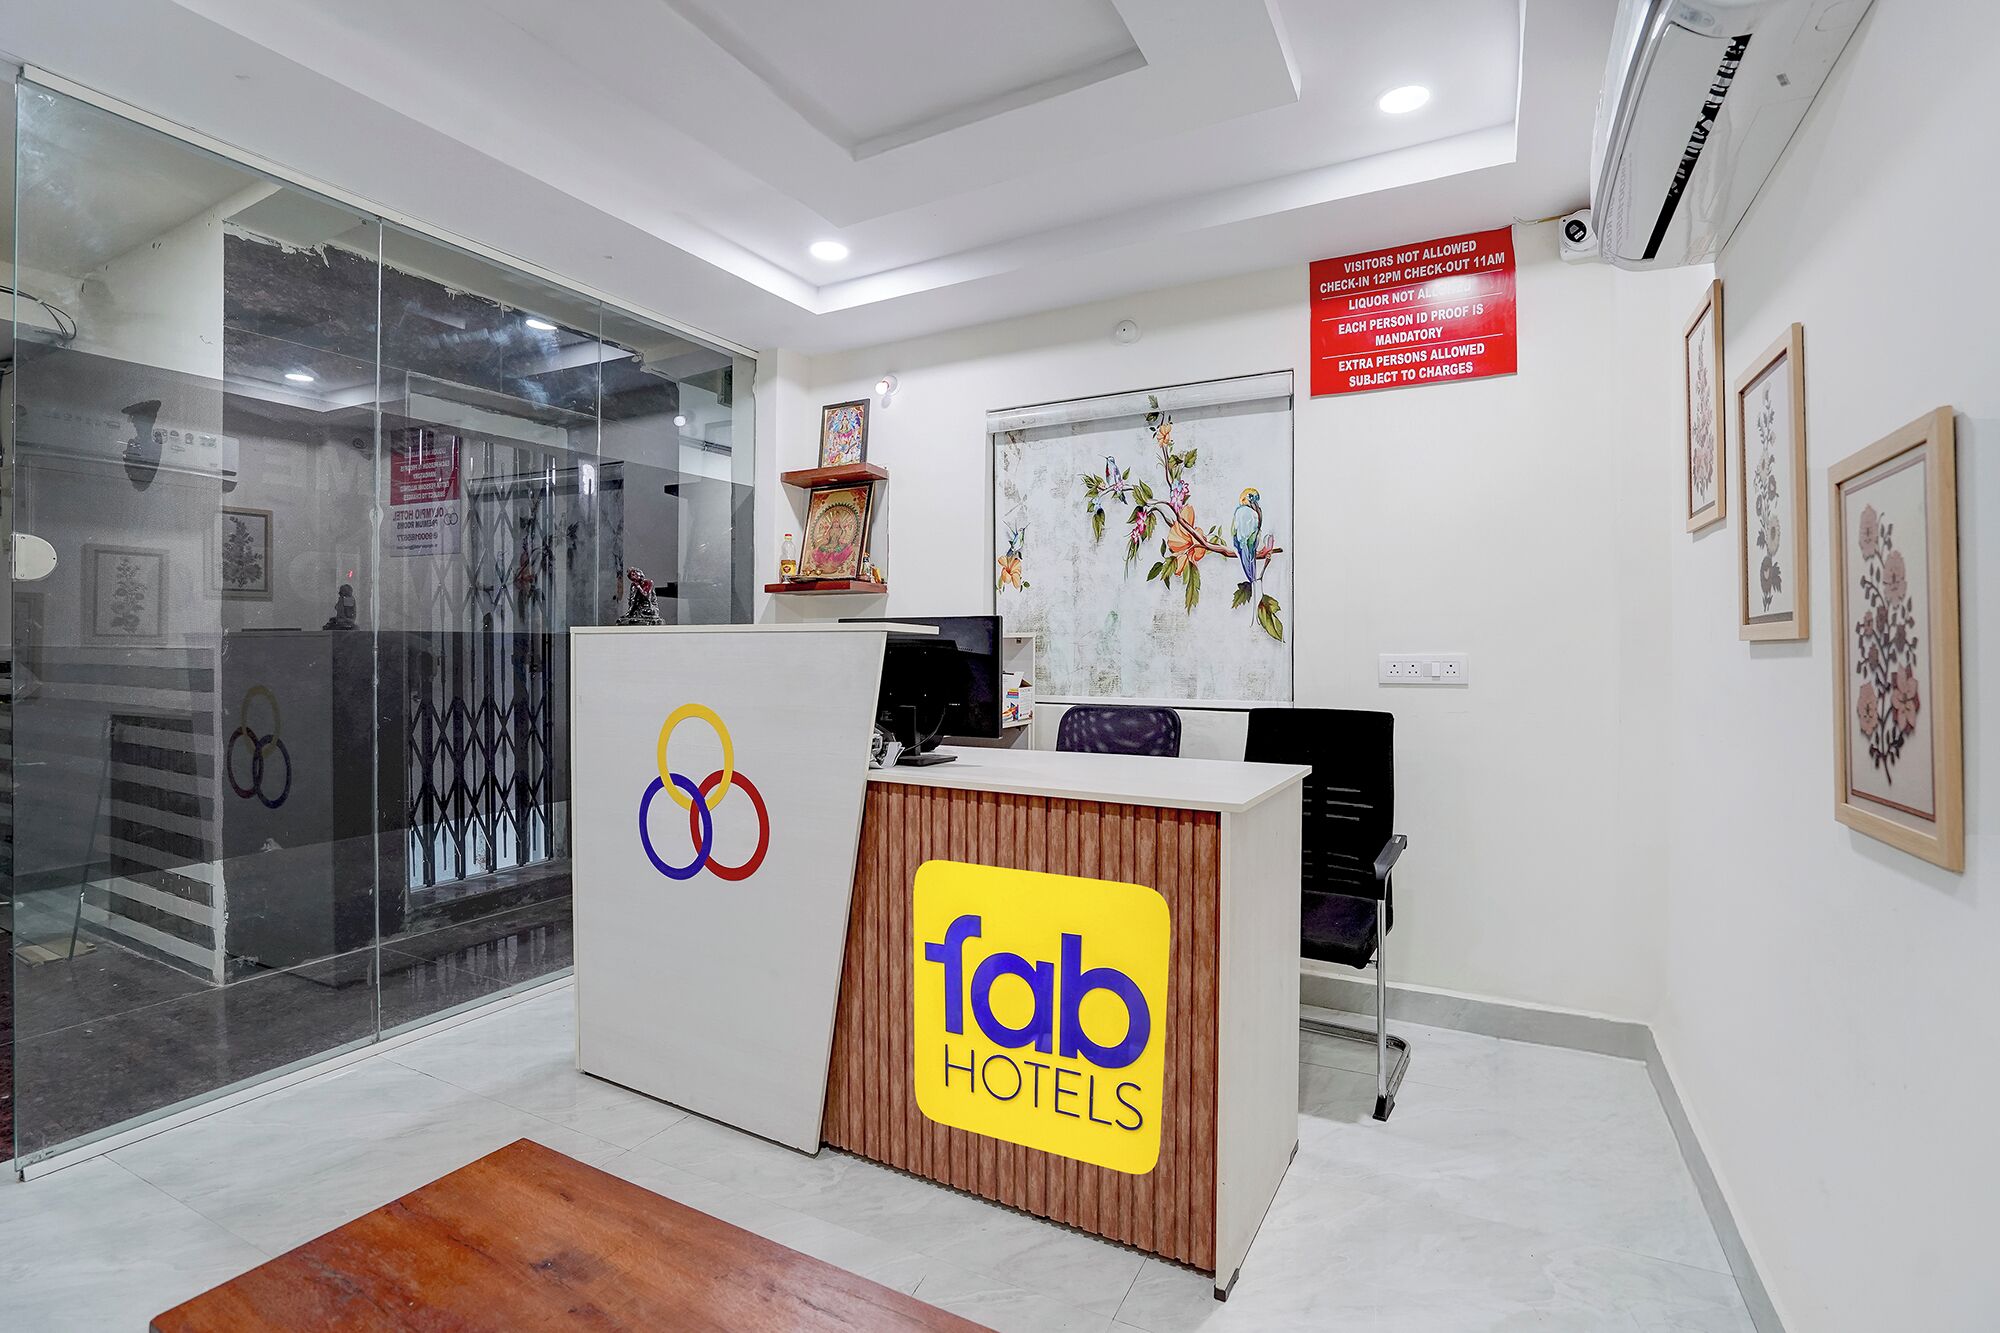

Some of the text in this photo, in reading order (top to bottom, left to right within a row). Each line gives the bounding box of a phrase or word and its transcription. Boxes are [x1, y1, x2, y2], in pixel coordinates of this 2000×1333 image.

[1319, 251, 1505, 294] CHECK-IN 12PM CHECK-OUT 11AM
[1344, 239, 1477, 274] VISITORS NOT ALLOWED
[1348, 292, 1389, 311] LIQUOR
[1392, 289, 1415, 304] NOT
[1338, 303, 1484, 335] EACH PERSON ID PROOF IS
[1375, 326, 1443, 347] MANDATORY
[1338, 342, 1485, 372] EXTRA PERSONS ALLOWED
[1348, 361, 1474, 388] SUBJECT TO CHARGES
[925, 914, 1151, 1069] fab
[944, 1043, 1144, 1131] HOTELS
